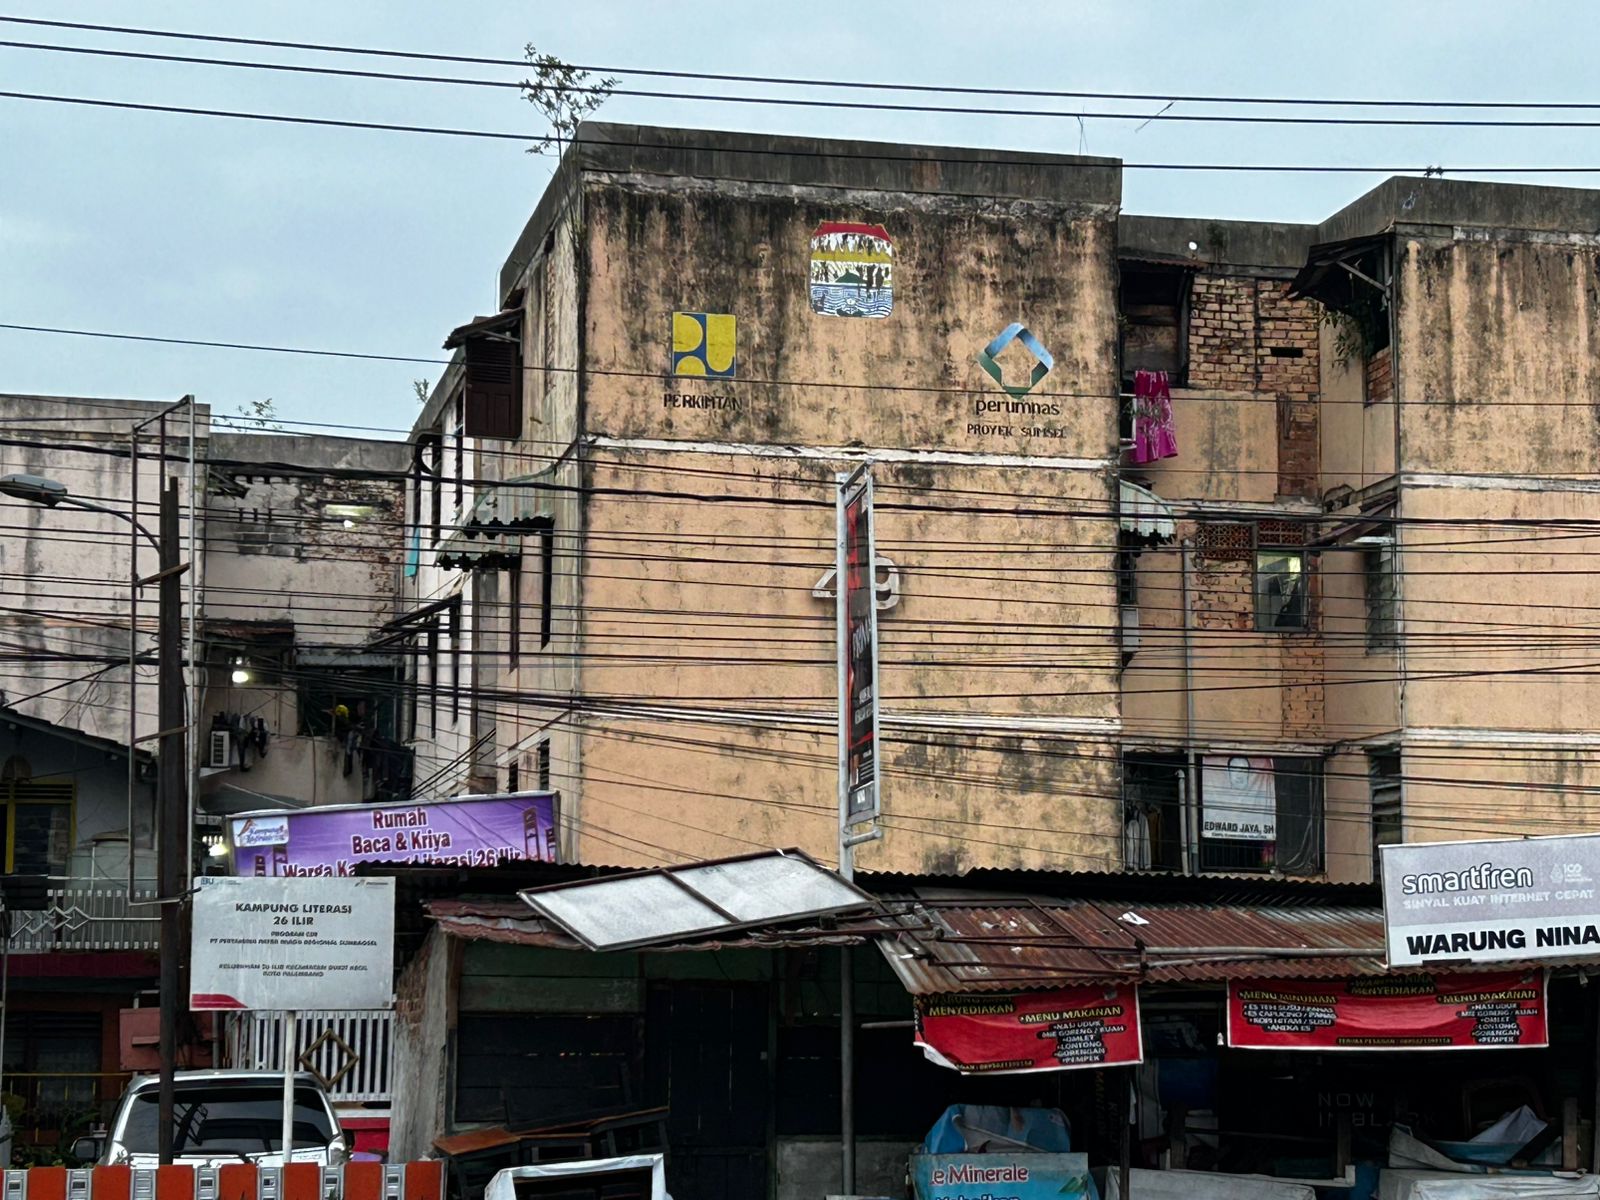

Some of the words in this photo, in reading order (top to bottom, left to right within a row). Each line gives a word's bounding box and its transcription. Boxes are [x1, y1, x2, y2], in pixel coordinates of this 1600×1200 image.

[664, 393, 742, 411] PERKIMTAN
[975, 399, 1060, 416] perumnas
[967, 423, 1013, 437] PROYEK
[373, 808, 427, 830] Rumah
[1204, 821, 1238, 832] EDWARD
[1263, 824, 1274, 834] SH
[352, 835, 391, 854] Baca
[396, 831, 408, 851] &
[411, 829, 451, 852] Kriya
[475, 850, 496, 868] 26
[1402, 862, 1533, 895] smartfren
[1403, 898, 1449, 910] SINYAL
[1453, 895, 1487, 907] KUAT
[1490, 892, 1551, 905] INTERNET
[1555, 889, 1595, 900] CEPAT
[236, 903, 298, 914] KAMPUNG
[302, 904, 352, 914] LITERASI
[273, 916, 288, 926] 26
[292, 916, 314, 926] ILIR
[1406, 929, 1526, 955] WARUNG
[1536, 925, 1600, 948] NINA
[1244, 991, 1277, 1000] MENU
[1352, 986, 1434, 996] MENYEDIAKAN
[1444, 995, 1477, 1003] MENU
[1480, 990, 1536, 1001] MAKANAN
[929, 1004, 1014, 1016] MENYEDIAKAN
[1025, 1012, 1060, 1022] MENU
[1062, 1006, 1121, 1019] MAKANAN
[948, 1163, 1029, 1184] Minerale
